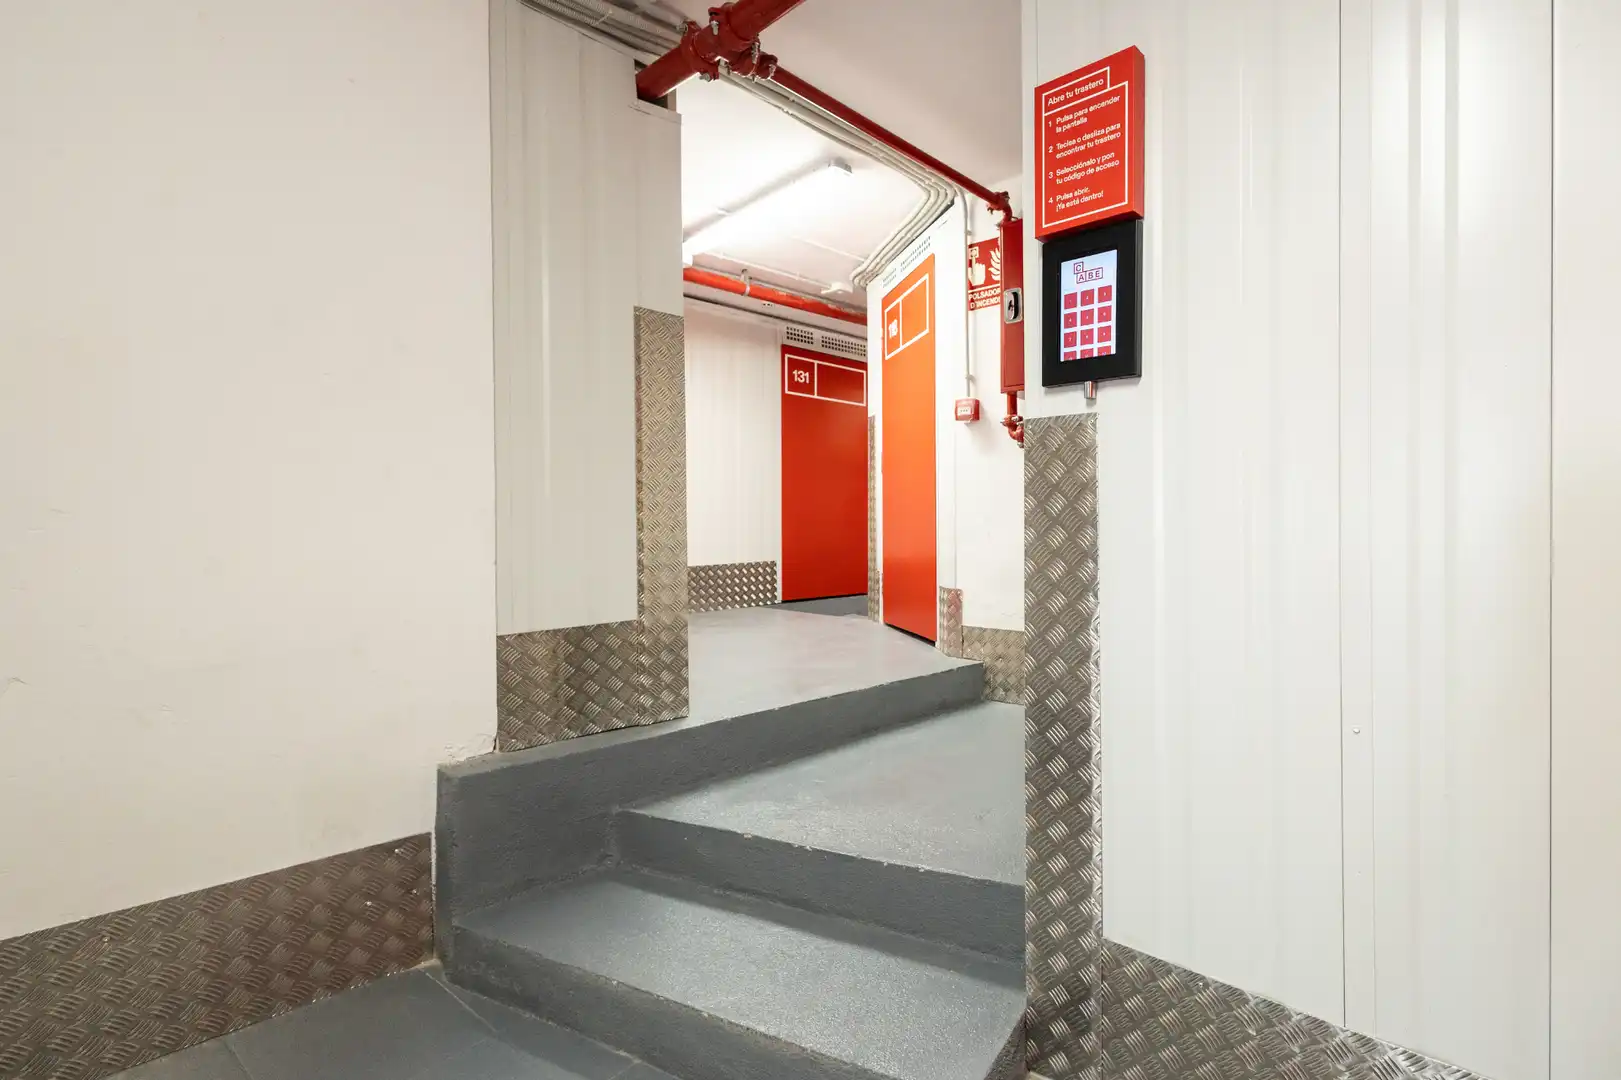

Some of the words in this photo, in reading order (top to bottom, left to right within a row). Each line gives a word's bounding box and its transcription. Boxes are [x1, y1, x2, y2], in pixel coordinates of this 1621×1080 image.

[1048, 93, 1064, 106] Abre
[1066, 91, 1073, 99] tu
[1074, 79, 1104, 95] trastero
[1056, 113, 1073, 124] Pulsa
[1074, 108, 1088, 119] para
[1089, 96, 1120, 111] encender
[1063, 117, 1087, 132] pantalla
[1082, 129, 1104, 140] desliza
[1106, 123, 1121, 134] para
[1056, 144, 1086, 159] encontrar
[1095, 132, 1121, 145] trastero
[1102, 152, 1115, 162] pon
[1064, 171, 1085, 182] código
[1096, 160, 1119, 172] acceso
[1056, 192, 1073, 202] Pulsa
[1080, 190, 1104, 203] dentro!
[792, 370, 809, 383] 131
